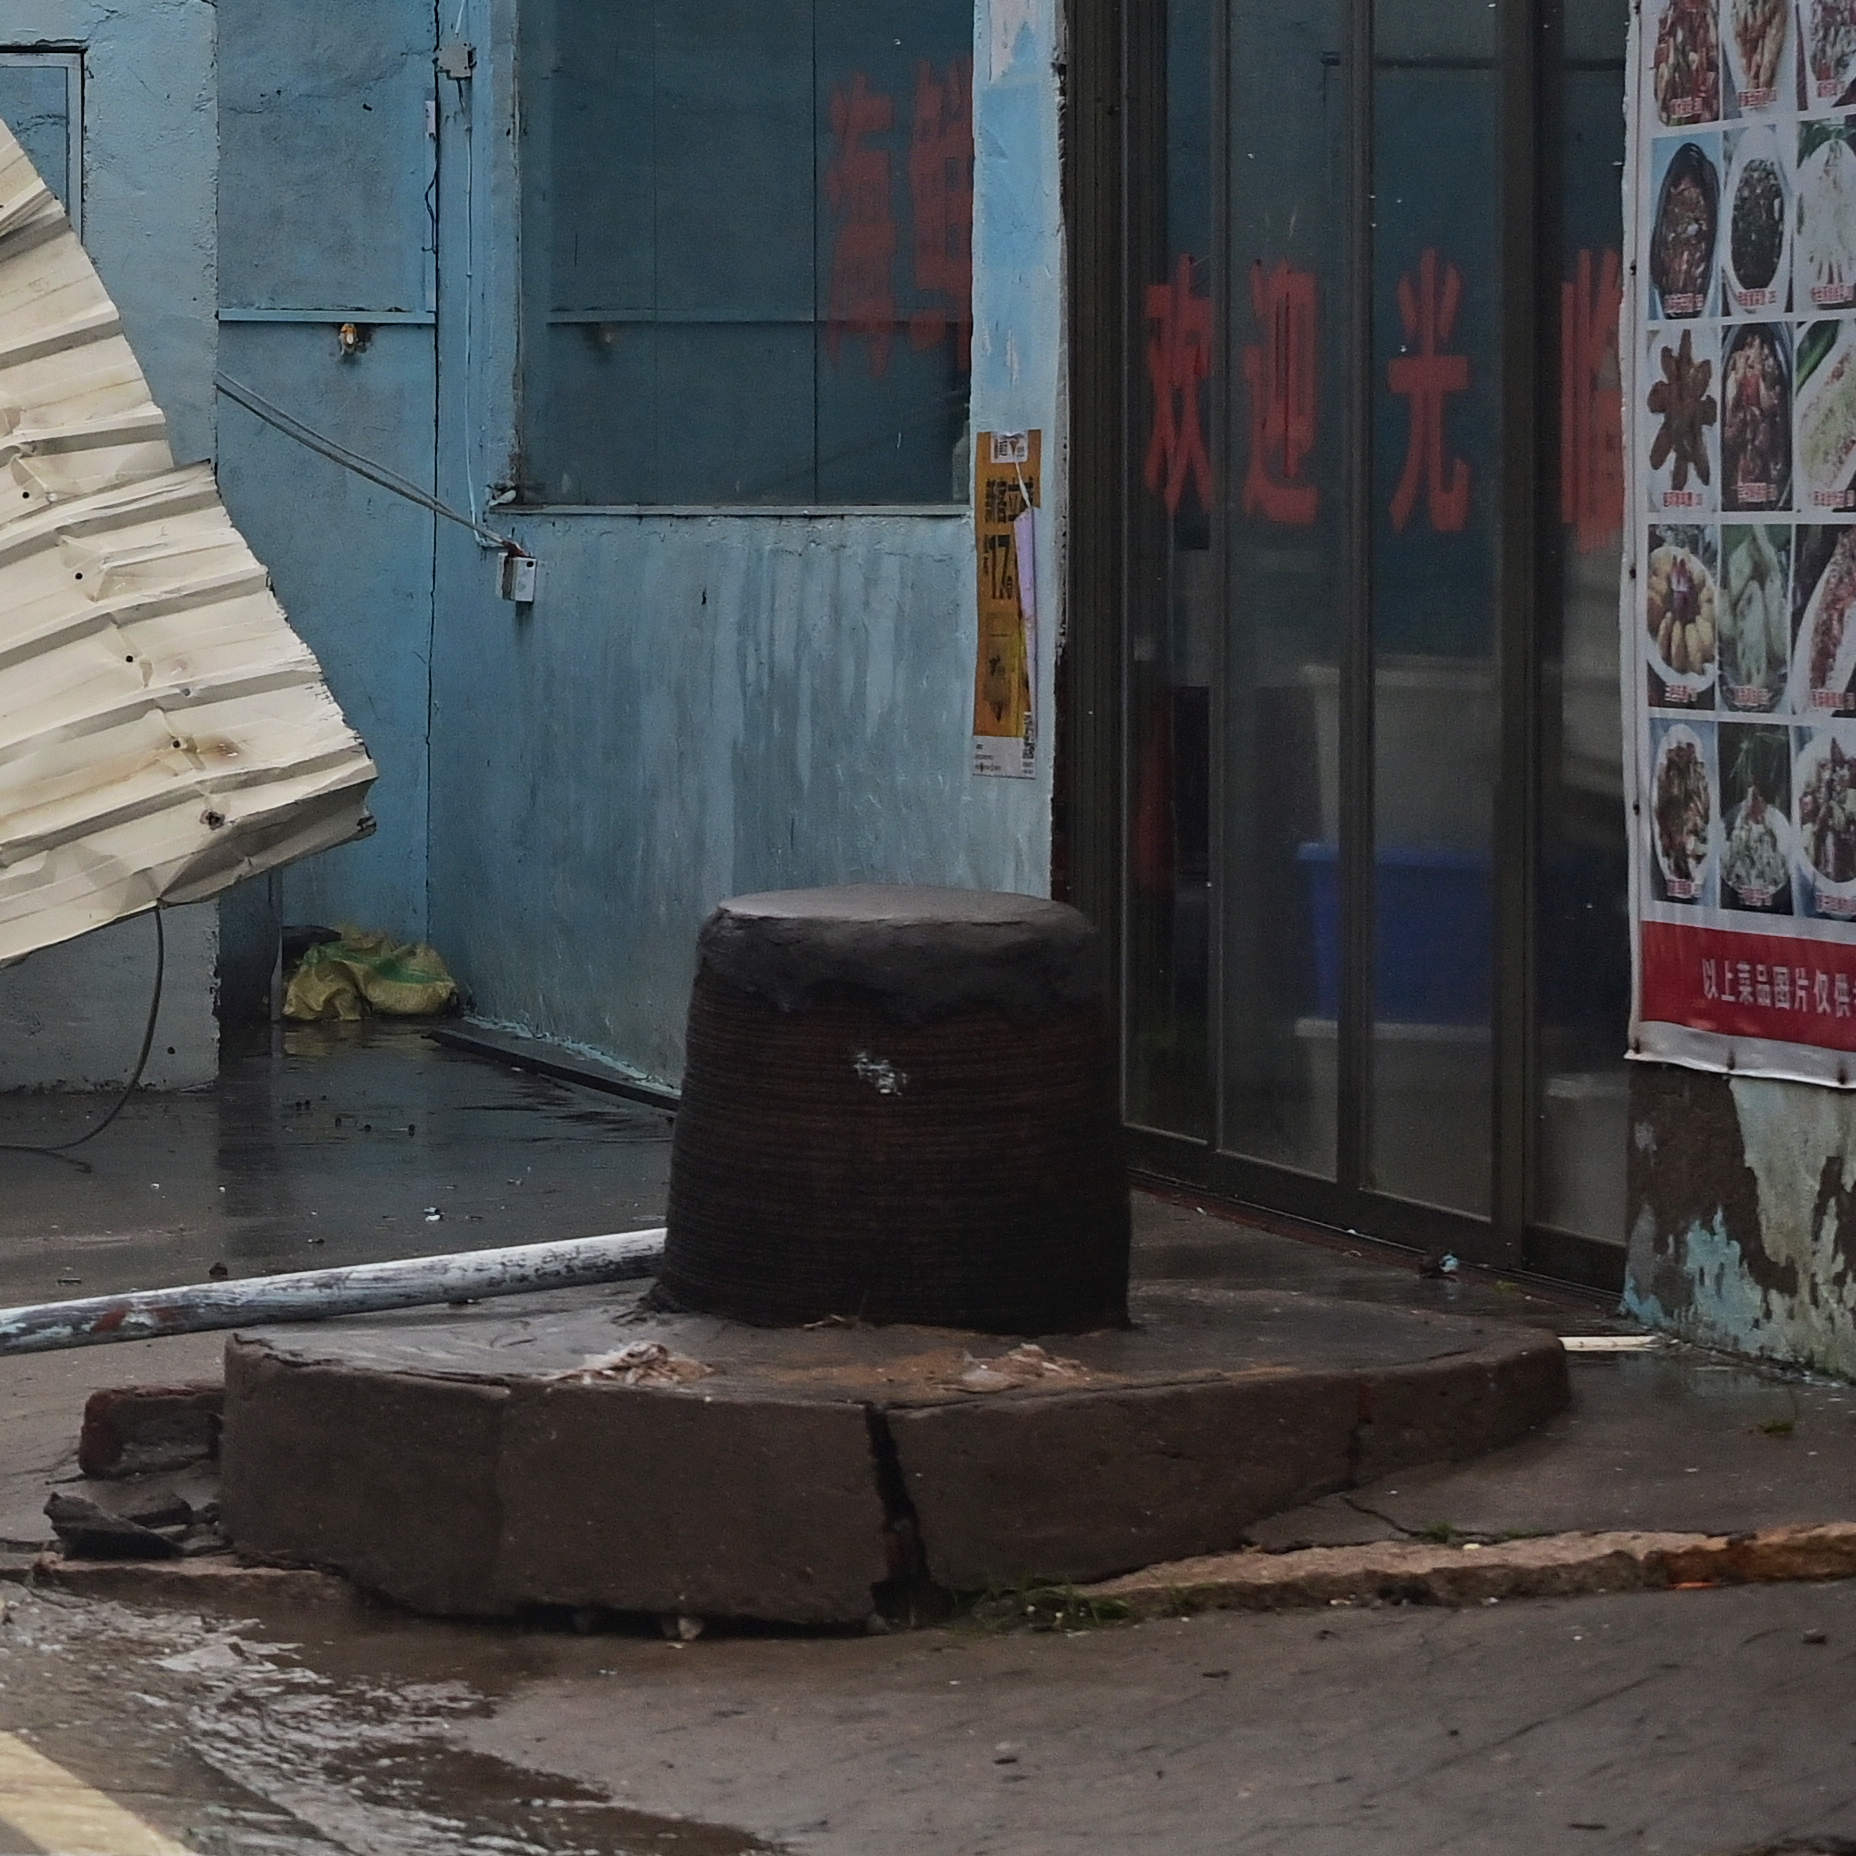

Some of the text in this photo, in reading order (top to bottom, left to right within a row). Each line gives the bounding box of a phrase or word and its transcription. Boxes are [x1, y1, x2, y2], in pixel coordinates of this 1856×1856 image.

[1702, 957, 1856, 1018] 以上菜品图片仅供
